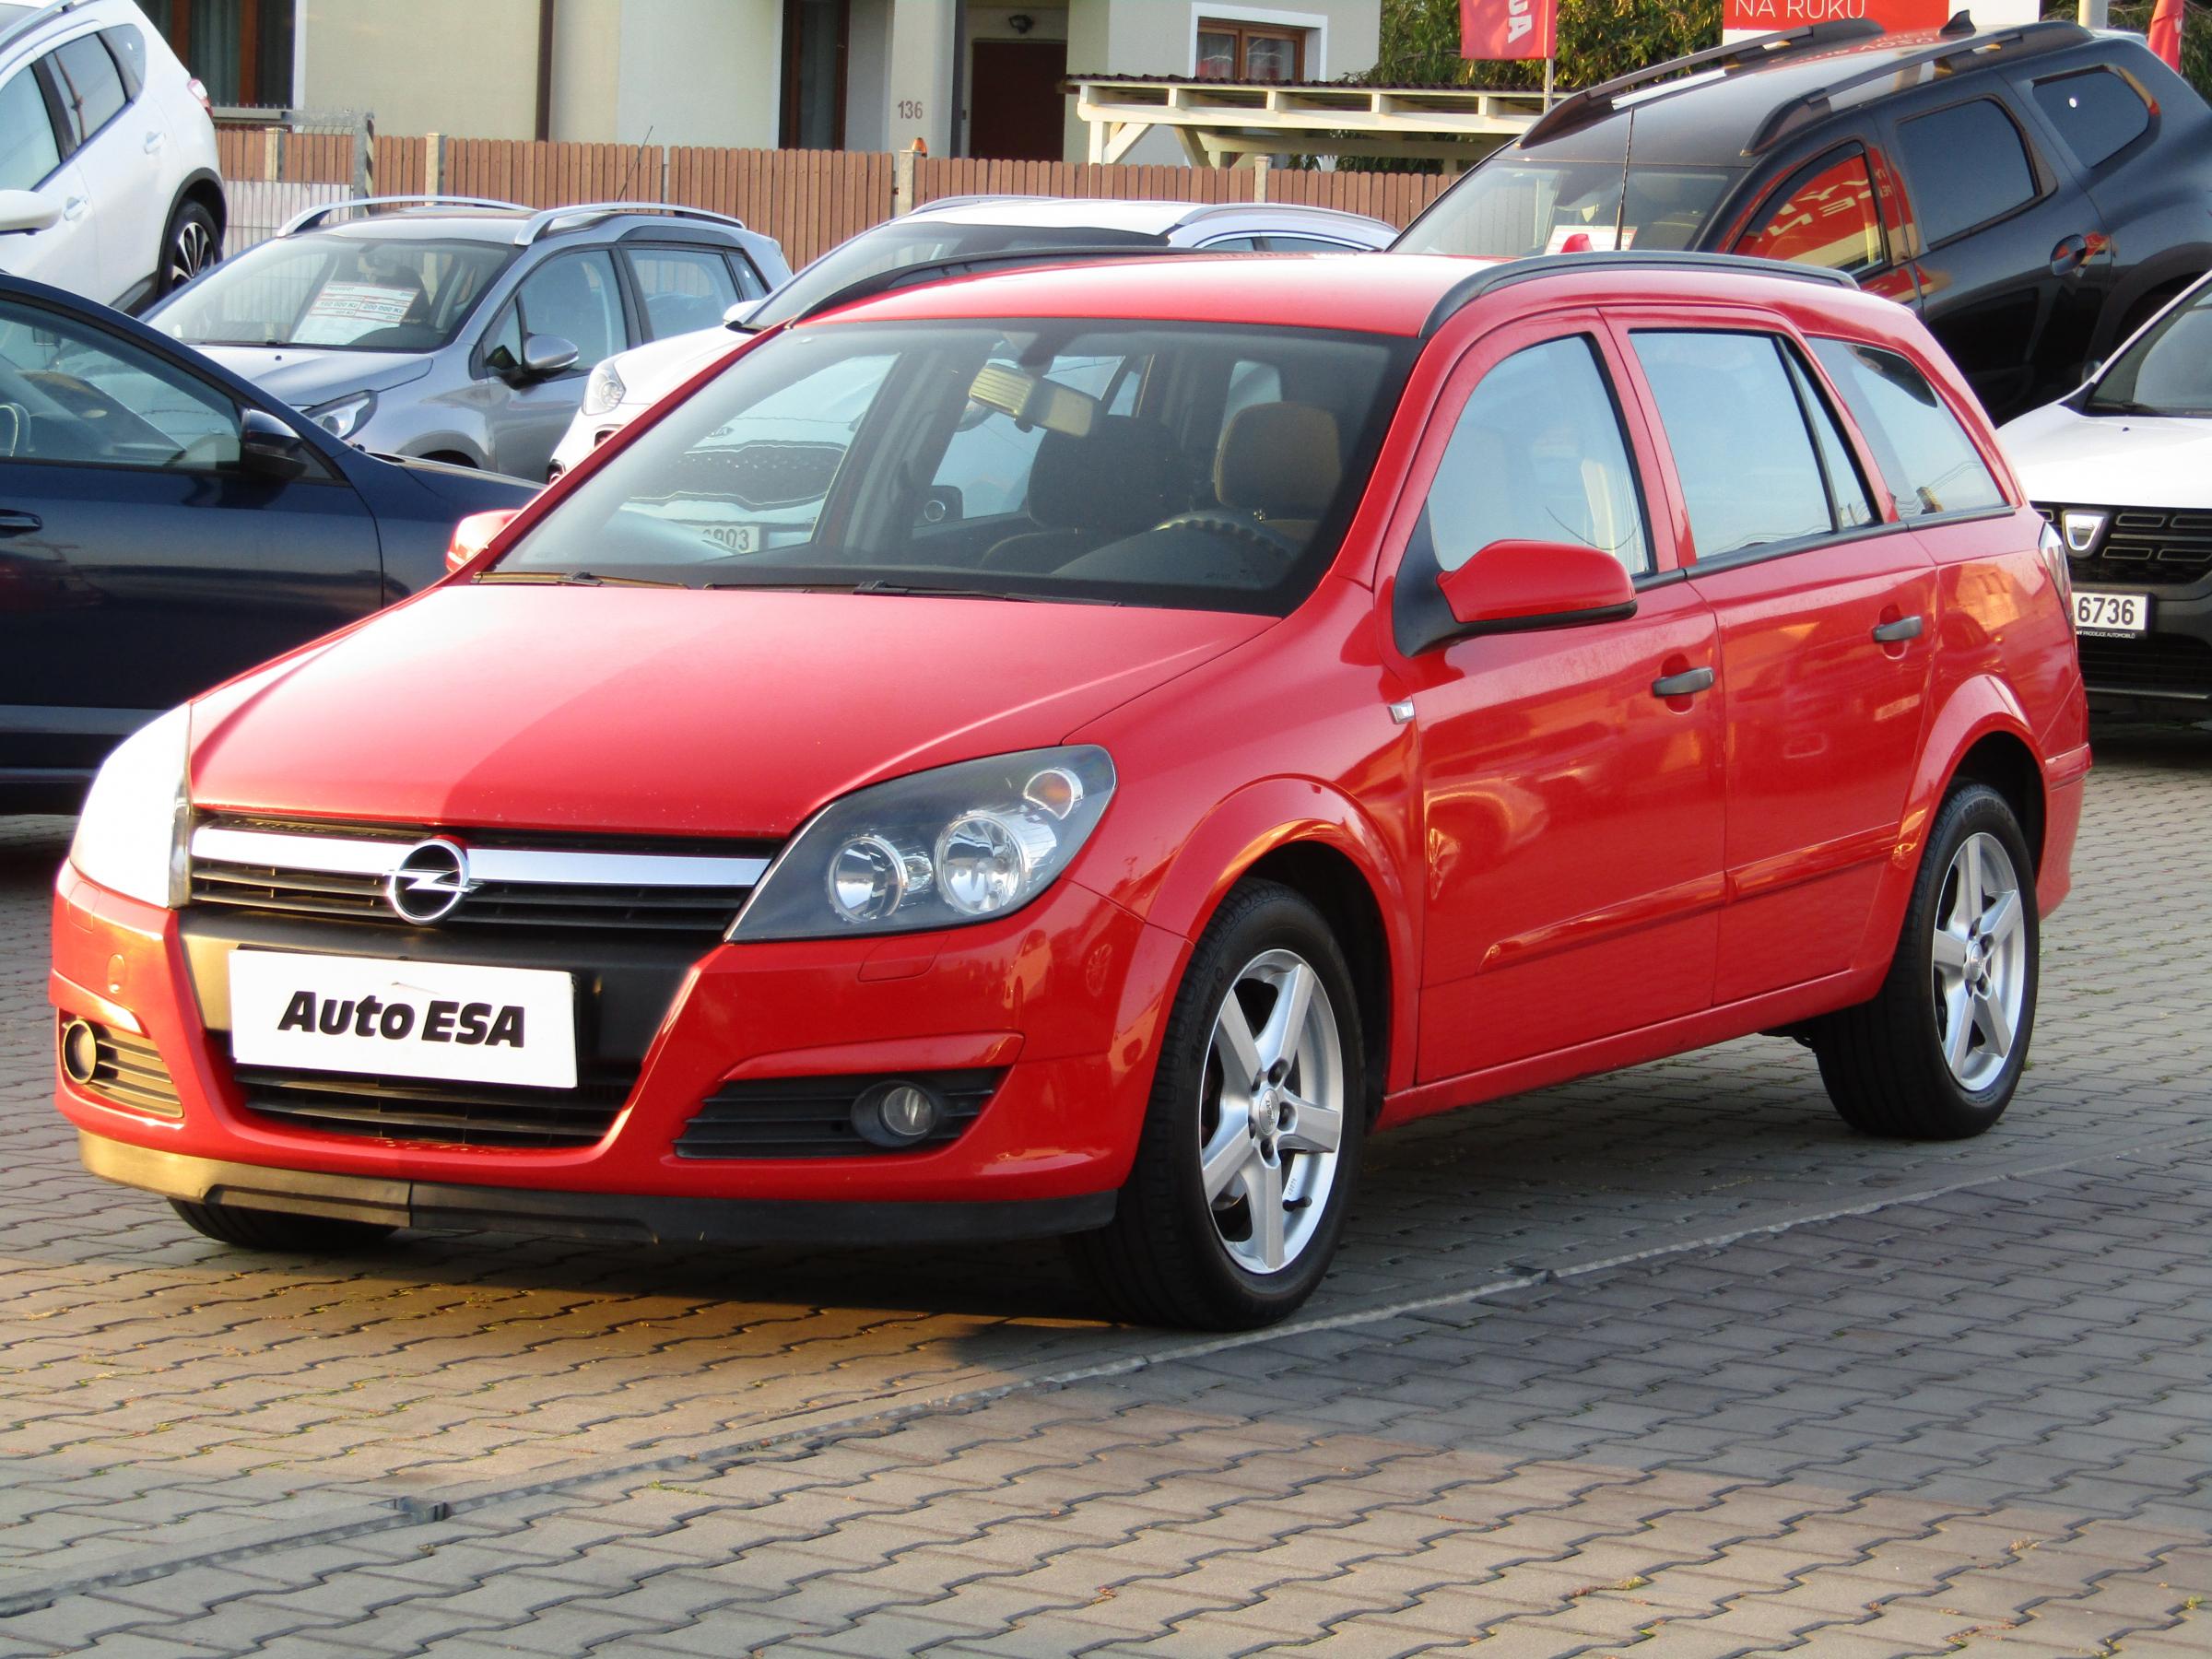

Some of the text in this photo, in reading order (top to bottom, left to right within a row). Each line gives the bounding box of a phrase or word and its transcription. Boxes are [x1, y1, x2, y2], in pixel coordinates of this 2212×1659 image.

[1735, 0, 1865, 19] NA RUKU
[898, 100, 924, 120] 136
[702, 528, 748, 550] 903
[2077, 597, 2135, 625] 6736
[277, 991, 524, 1048] Auto ESA
